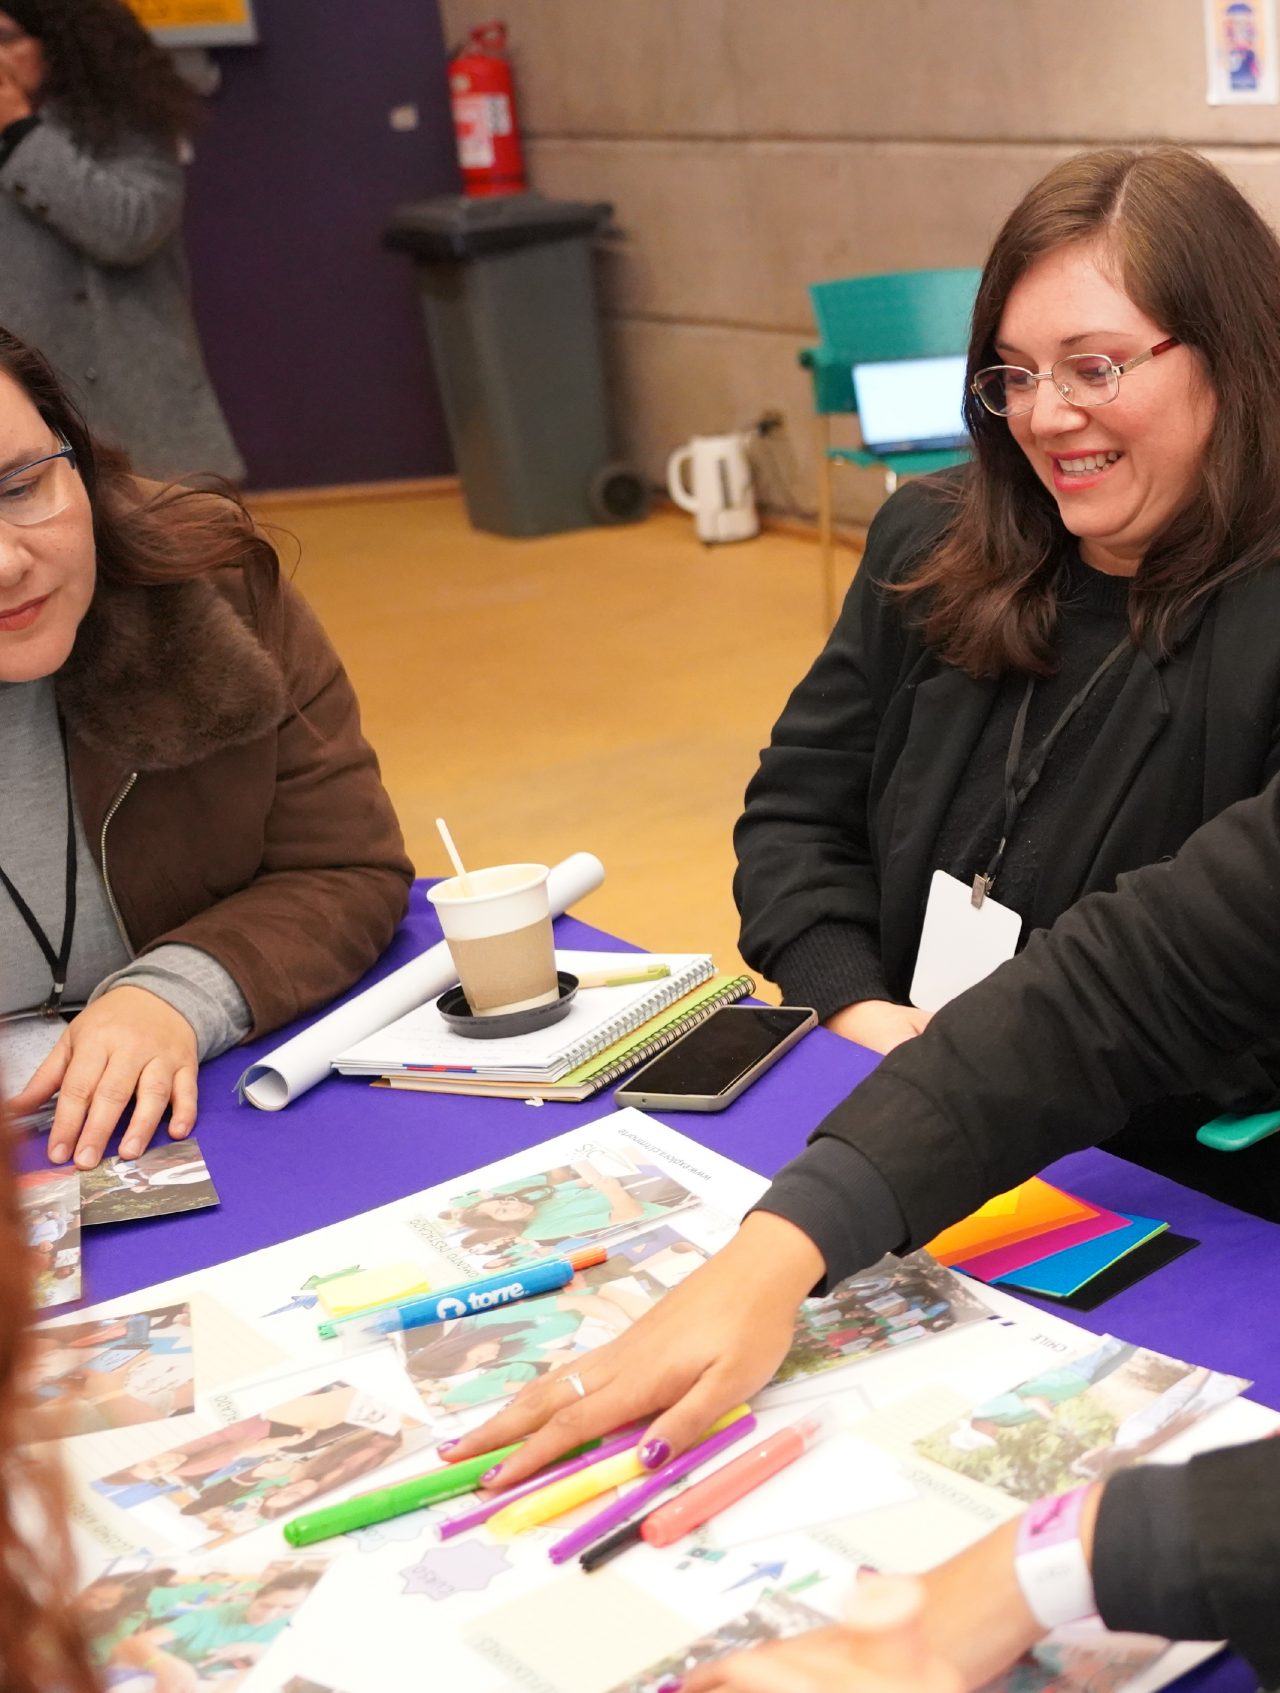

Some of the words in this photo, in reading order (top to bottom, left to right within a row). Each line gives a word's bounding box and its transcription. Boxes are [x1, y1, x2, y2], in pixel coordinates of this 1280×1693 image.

[447, 1252, 480, 1279] OMENTO
[467, 1282, 524, 1310] torre
[1030, 1332, 1068, 1353] CHILE
